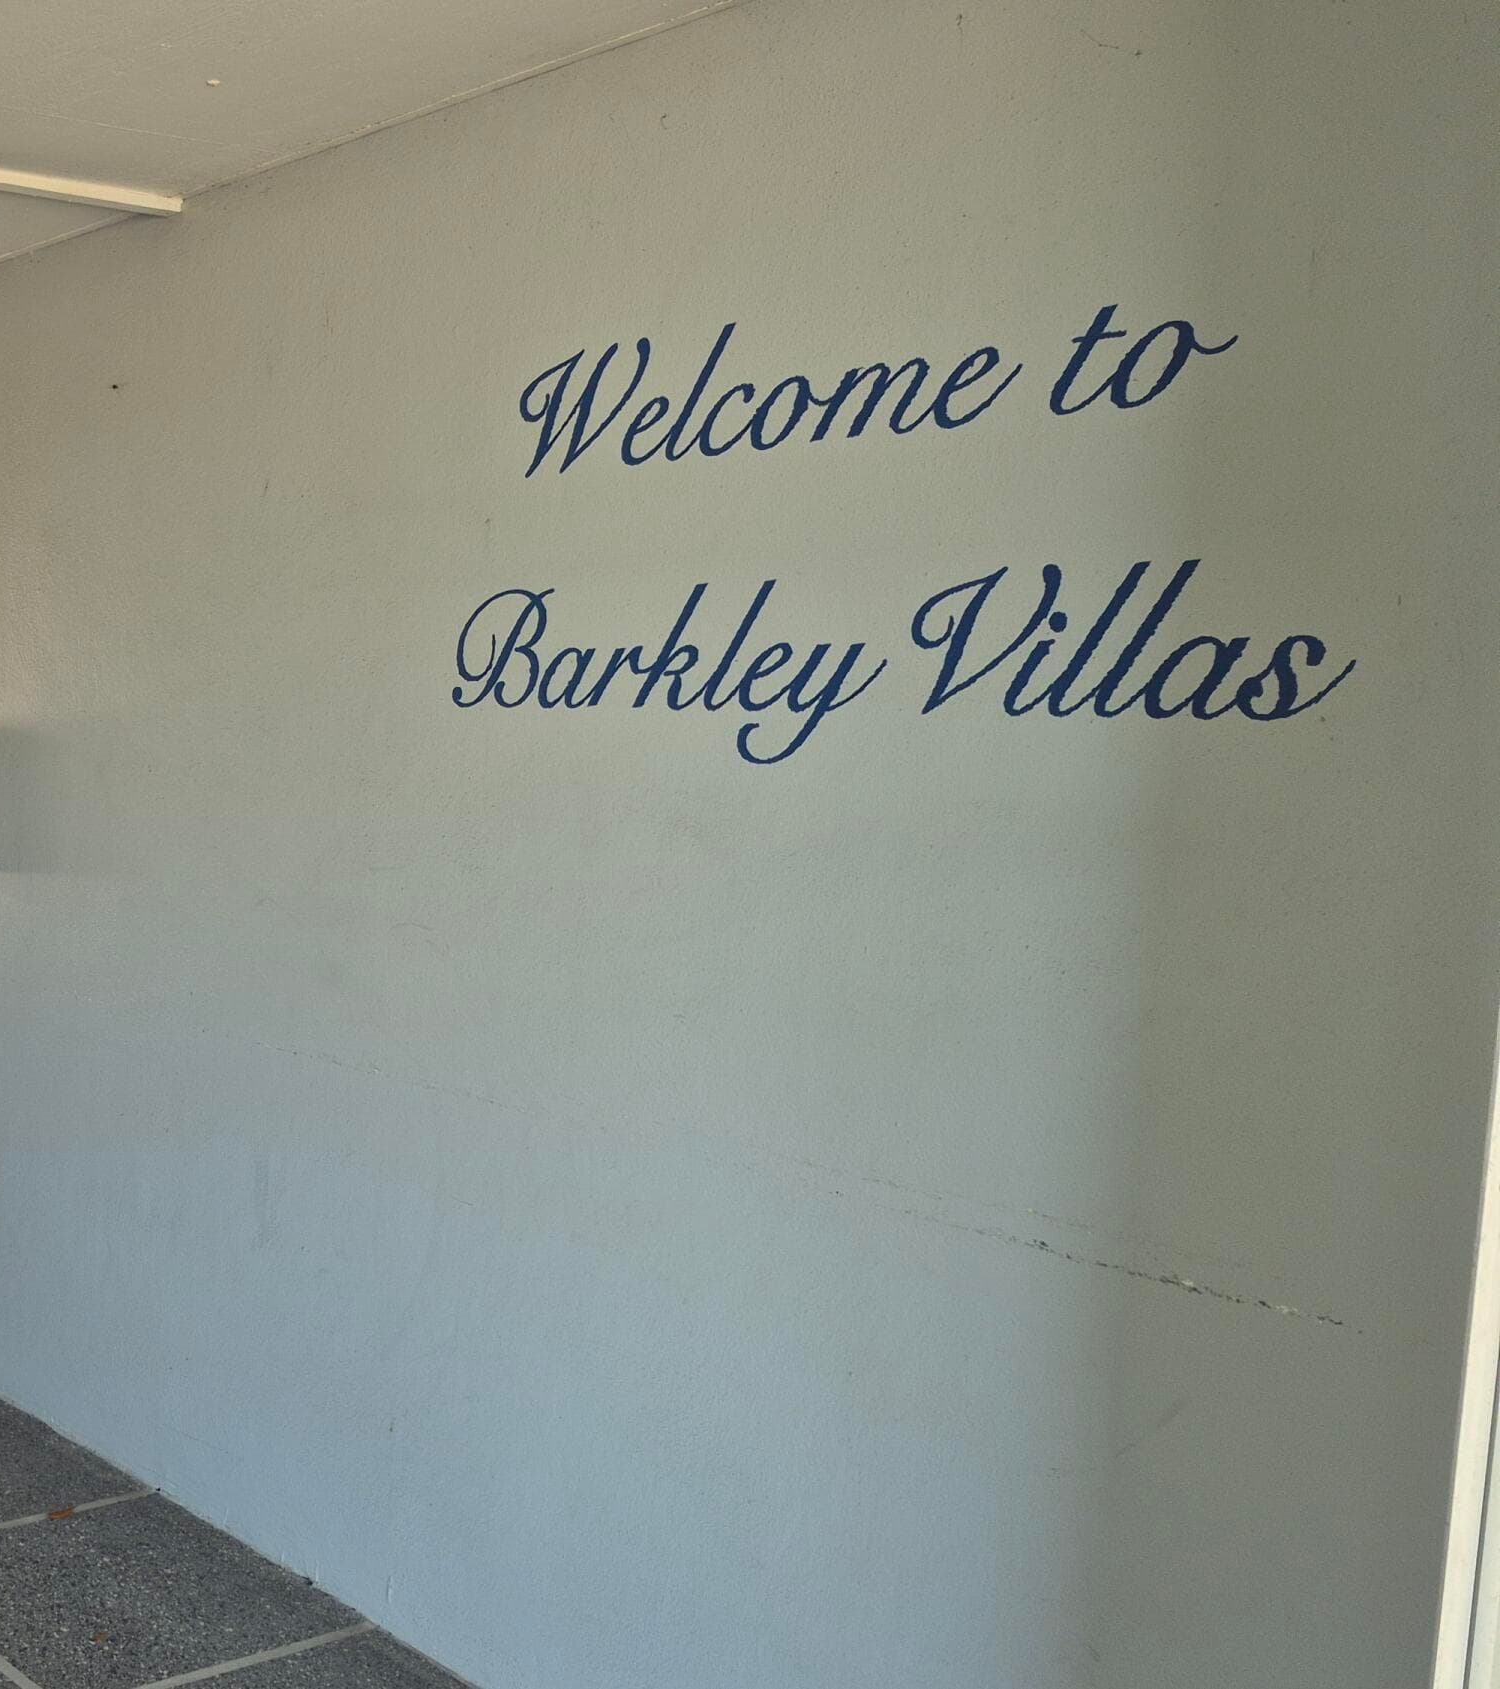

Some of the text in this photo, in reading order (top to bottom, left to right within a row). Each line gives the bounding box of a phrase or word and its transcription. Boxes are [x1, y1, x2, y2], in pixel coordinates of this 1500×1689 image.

[518, 304, 1238, 478] Welcome to
[452, 558, 1357, 765] Barkley Villas
